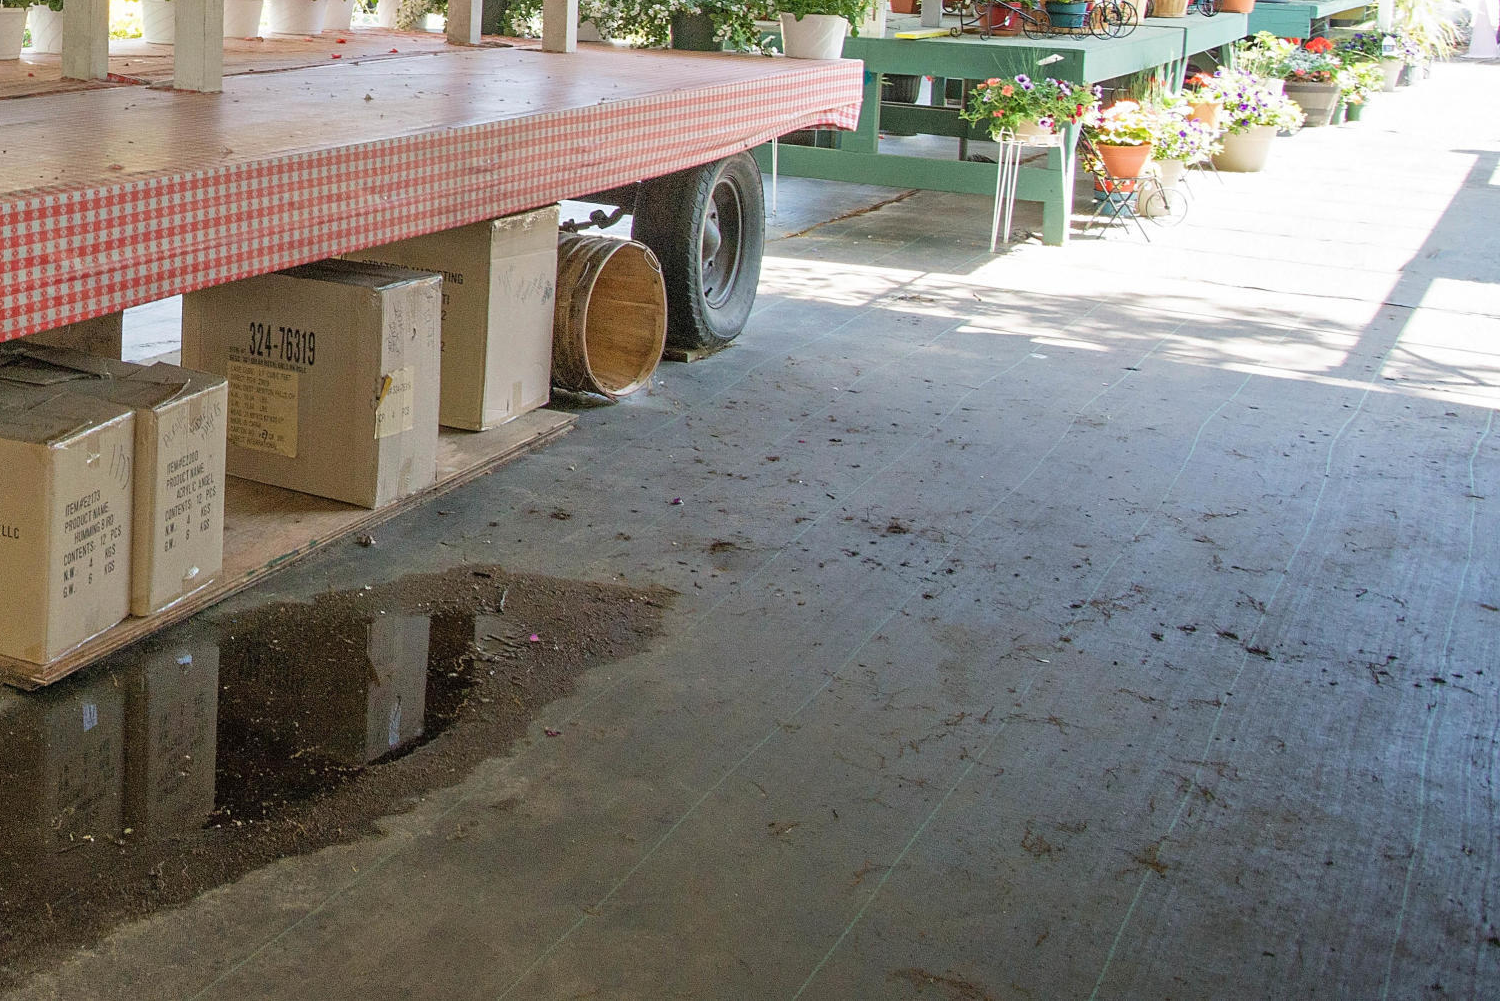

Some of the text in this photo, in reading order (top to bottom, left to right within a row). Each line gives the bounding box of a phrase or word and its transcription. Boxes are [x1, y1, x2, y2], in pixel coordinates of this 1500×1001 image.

[249, 321, 316, 366] 324-76319
[166, 469, 189, 491] PRODUCT
[64, 501, 109, 534] PRODUCT NAME
[100, 533, 107, 547] 12
[110, 524, 122, 541] PCS
[104, 543, 116, 559] KGS
[104, 559, 115, 576] KGS
